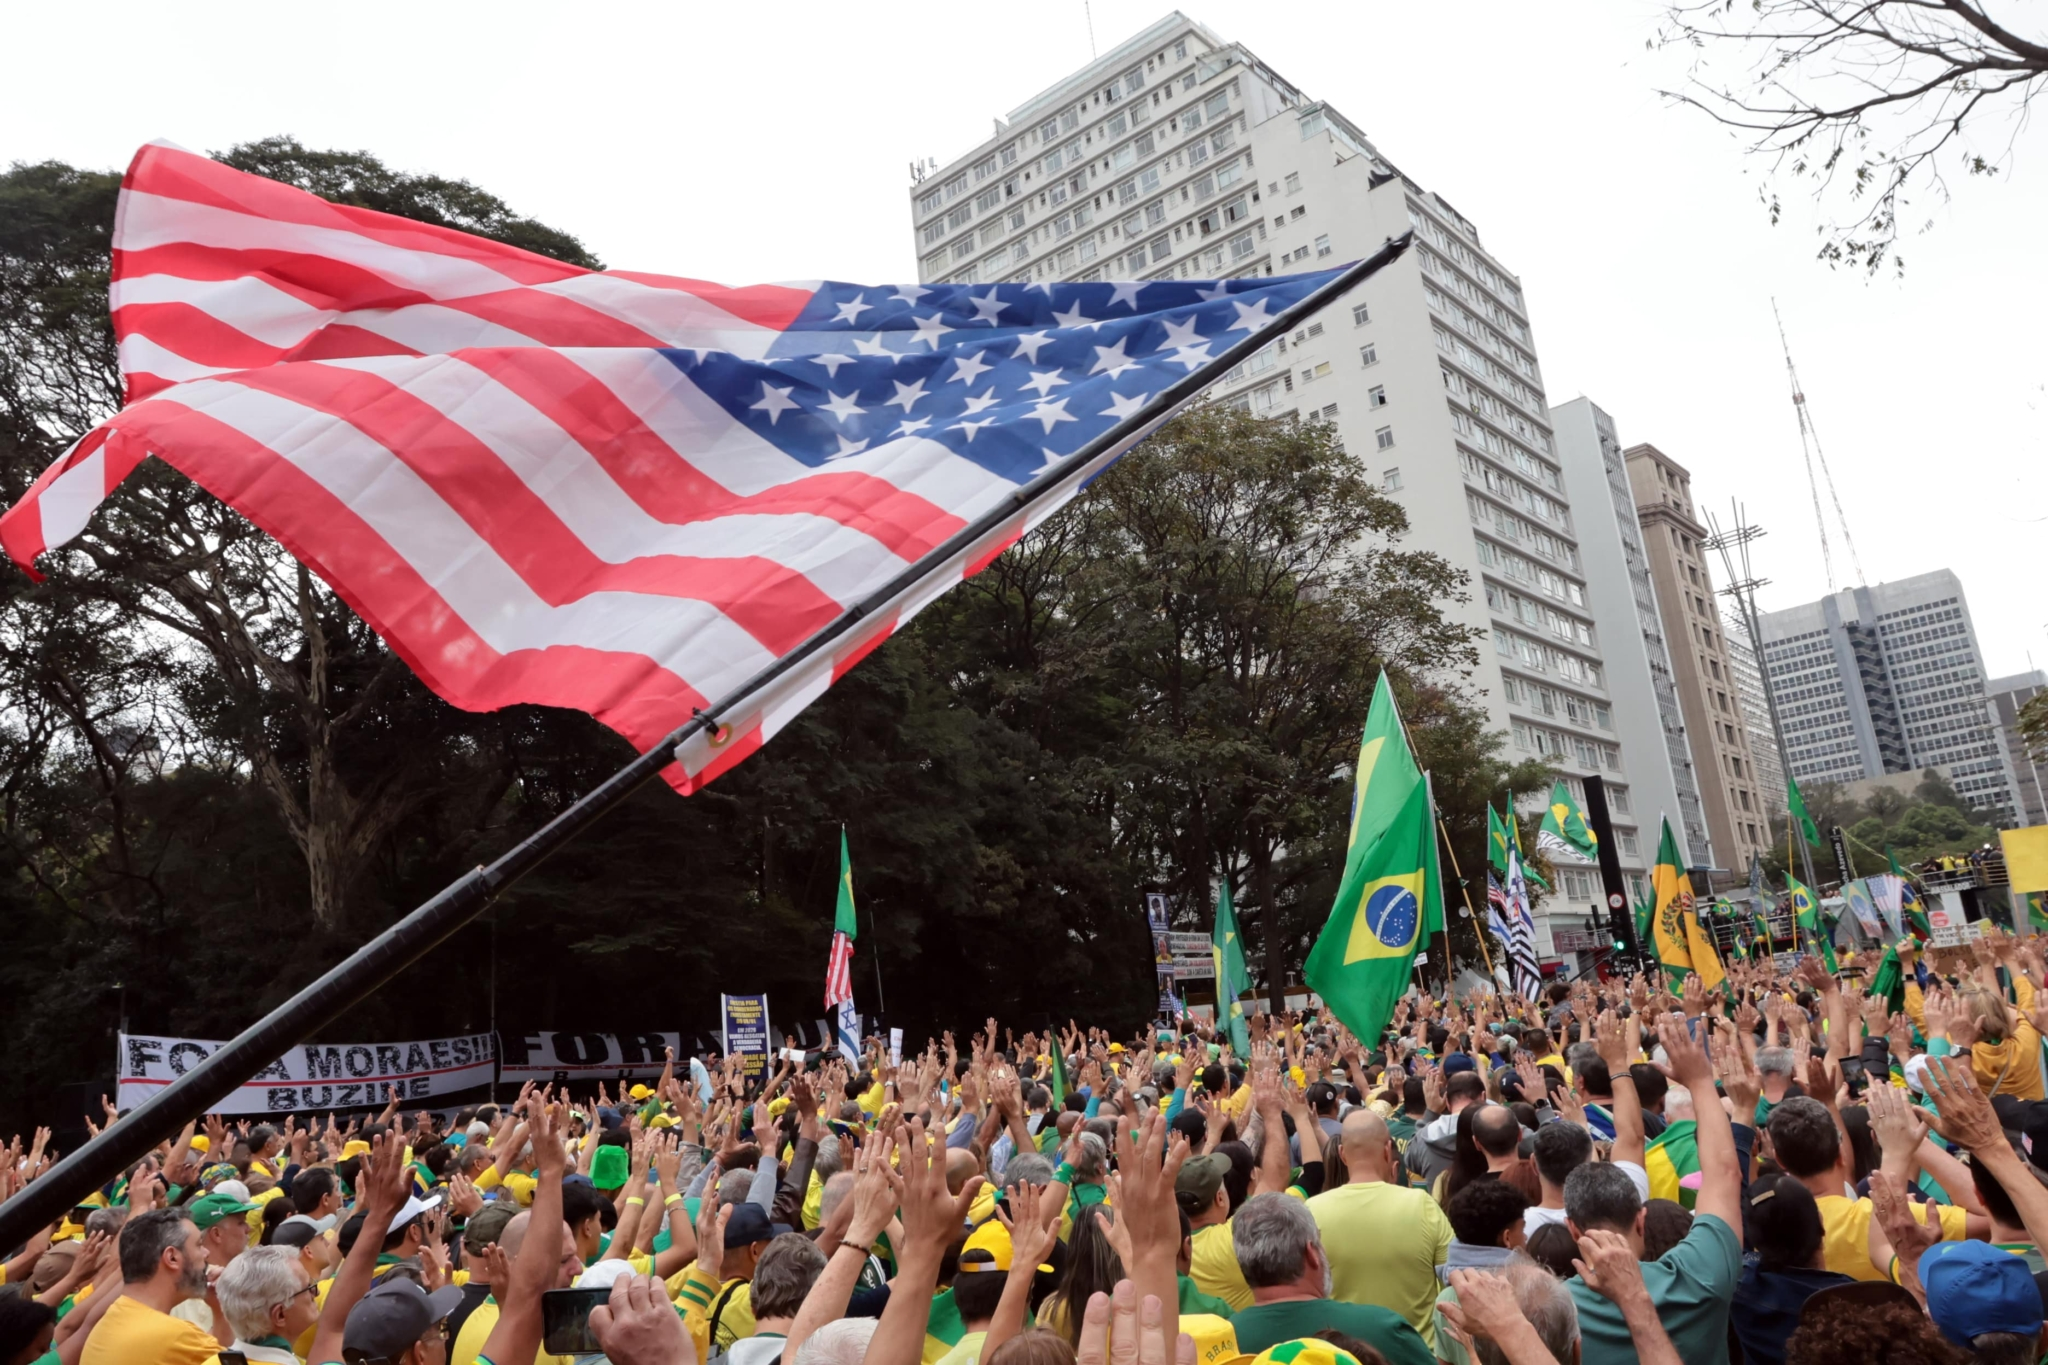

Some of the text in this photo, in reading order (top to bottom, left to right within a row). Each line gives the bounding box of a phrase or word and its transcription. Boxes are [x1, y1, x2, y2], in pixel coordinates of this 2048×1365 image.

[1835, 842, 1846, 870] Azevedo
[127, 1038, 291, 1081] FOA
[267, 1076, 431, 1111] BUZINE
[1205, 1339, 1234, 1363] BRAS
